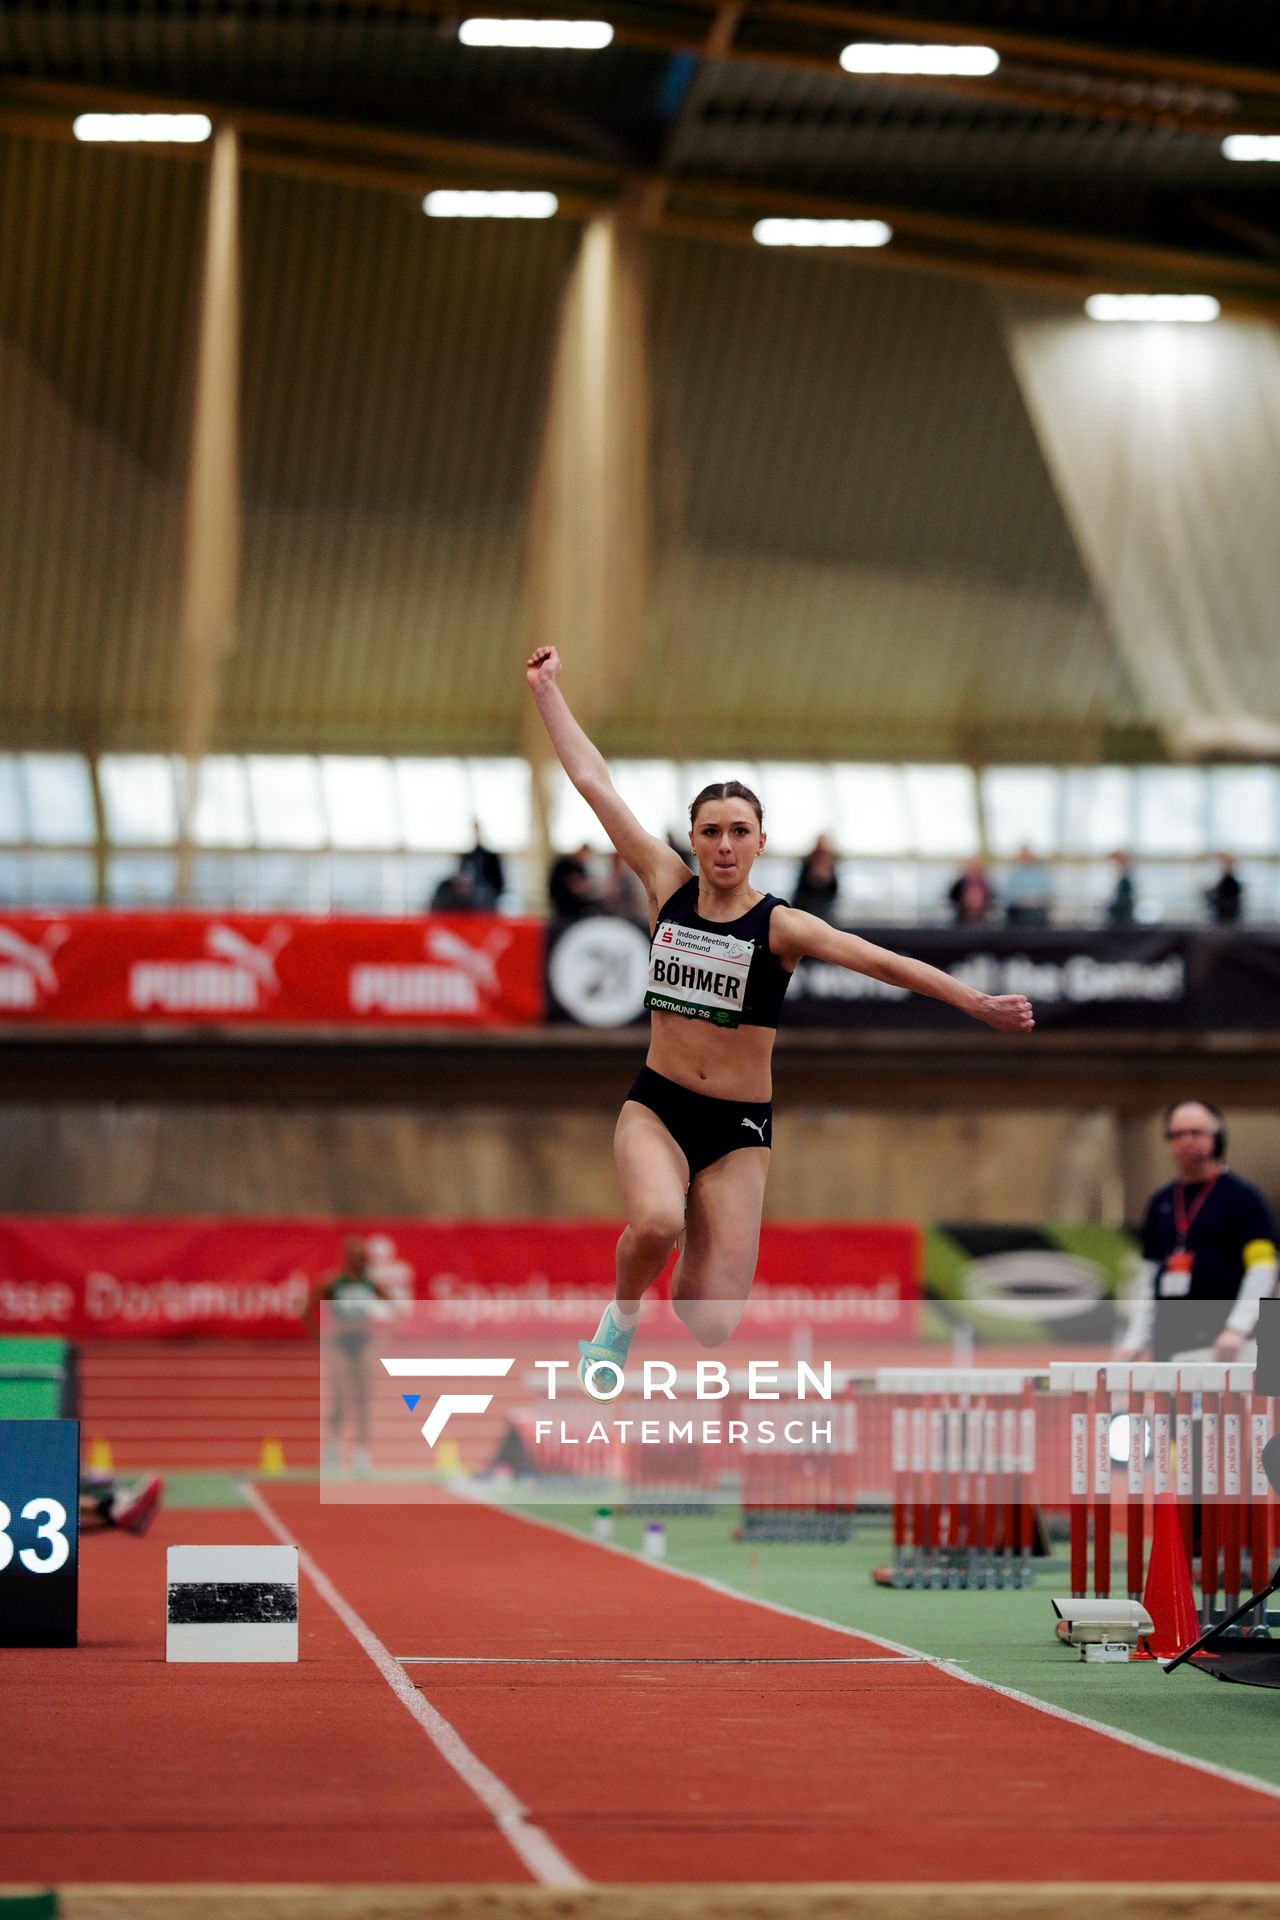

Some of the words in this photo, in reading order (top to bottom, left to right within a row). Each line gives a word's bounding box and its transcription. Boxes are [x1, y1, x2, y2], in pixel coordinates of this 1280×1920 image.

[675, 938, 711, 953] Dortmund
[677, 930, 700, 941] Indoor
[701, 935, 730, 949] Meeting
[653, 956, 741, 999] BÖHMER
[650, 998, 697, 1016] DORTMUND
[698, 1009, 711, 1019] 26
